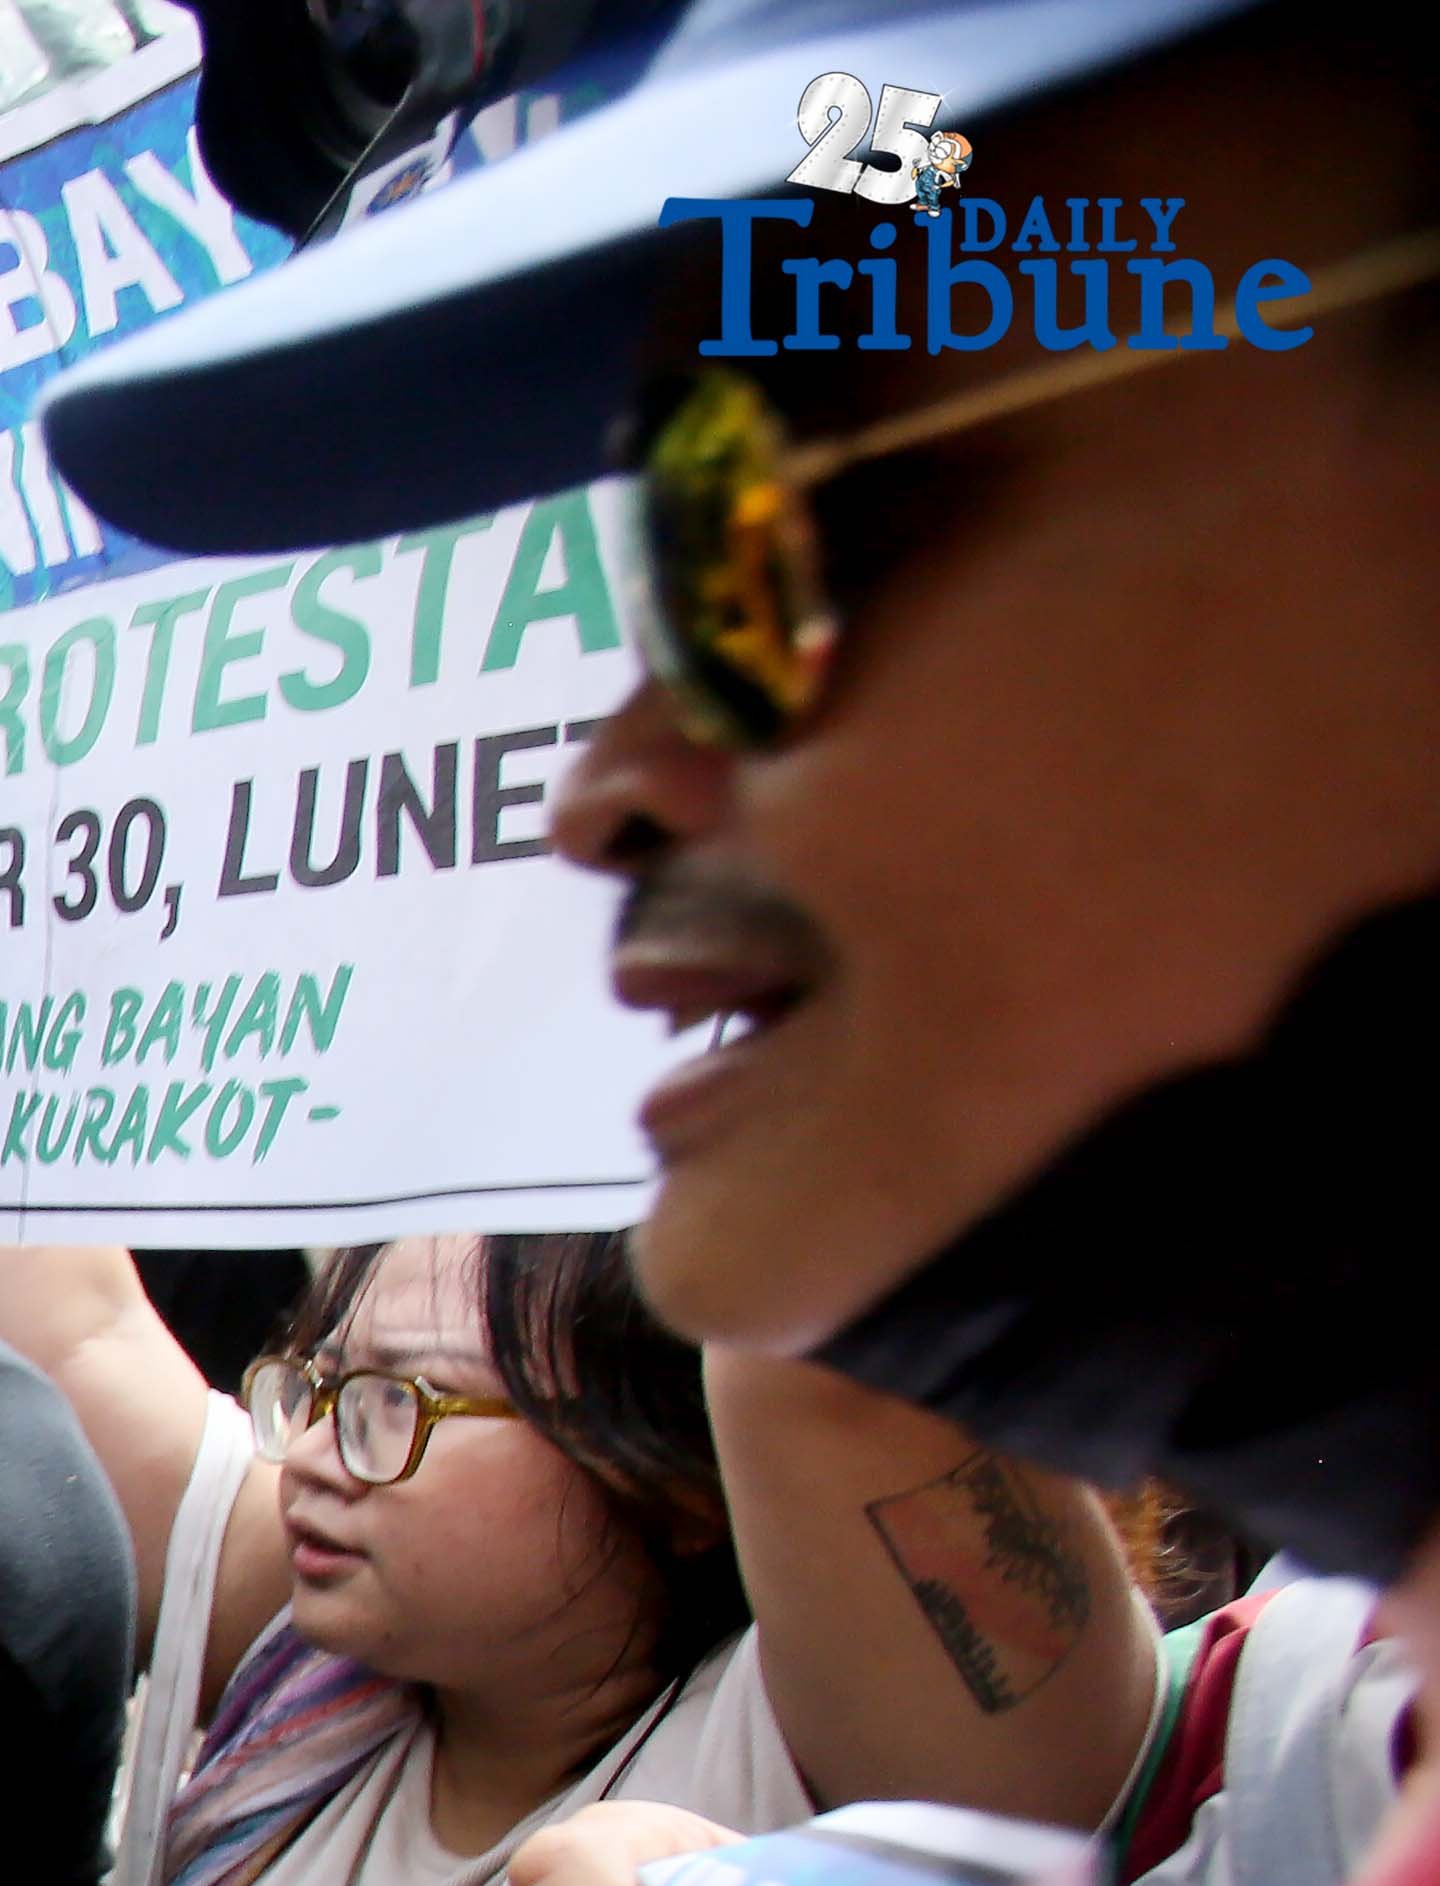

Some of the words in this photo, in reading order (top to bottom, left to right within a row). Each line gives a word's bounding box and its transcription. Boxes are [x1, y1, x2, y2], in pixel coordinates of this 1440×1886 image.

[51, 797, 183, 939] 30,
[218, 714, 618, 899] LUNE
[101, 962, 355, 1075] BAYAN
